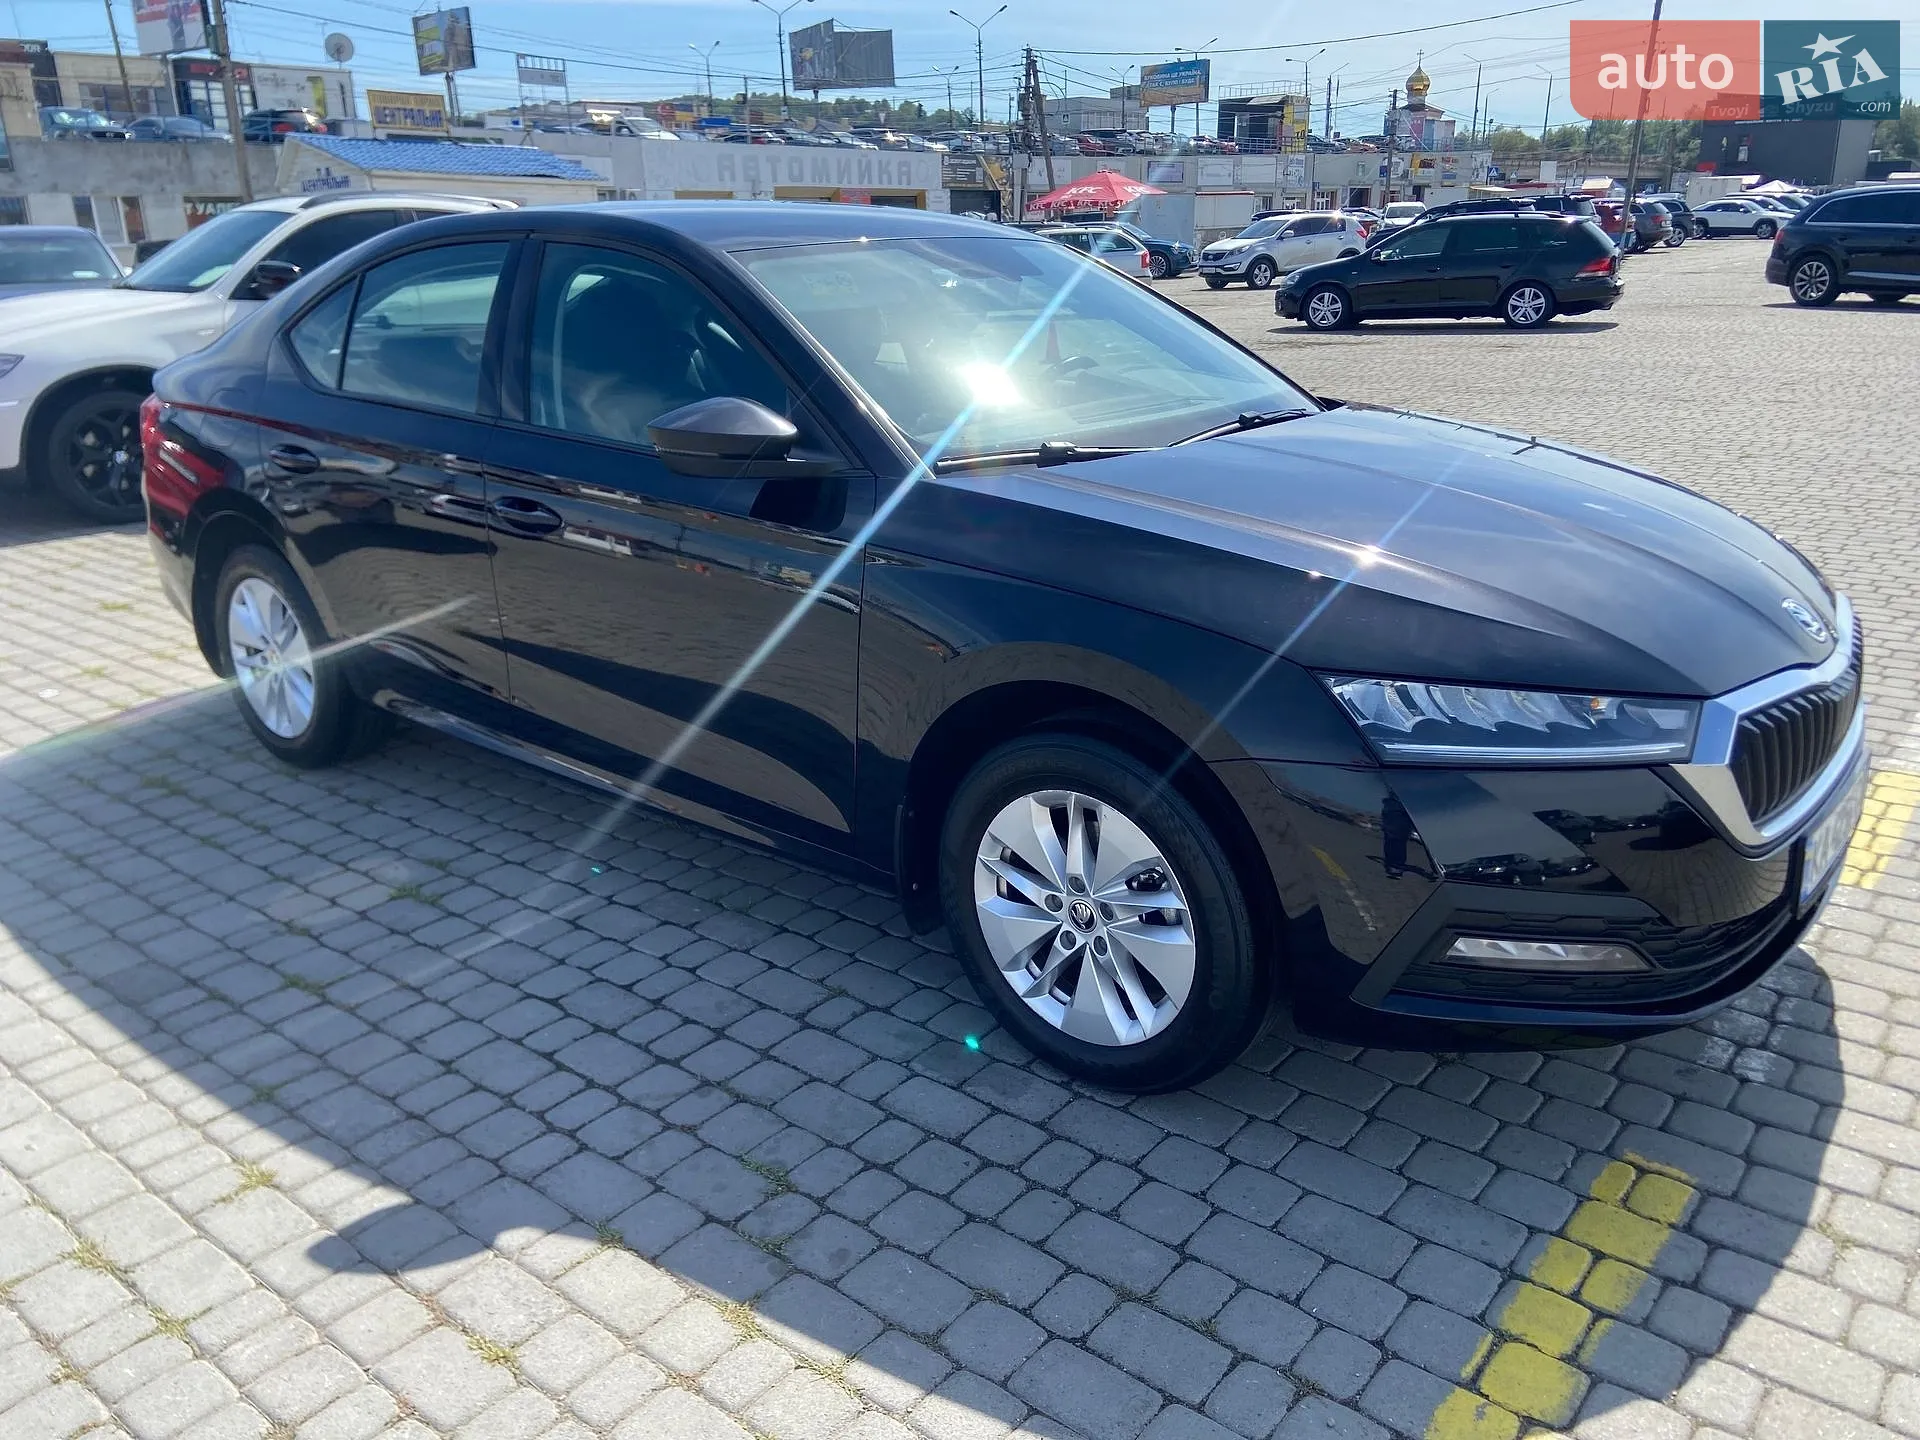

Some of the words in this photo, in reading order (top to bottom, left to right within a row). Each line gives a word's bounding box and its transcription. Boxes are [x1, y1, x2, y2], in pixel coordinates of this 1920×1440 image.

[1710, 104, 1749, 119] Tvoyi
[716, 152, 912, 186] АВТОМИЙКА
[1066, 186, 1103, 195] KFC
[1029, 203, 1046, 211] KFC
[1050, 201, 1067, 209] KFC
